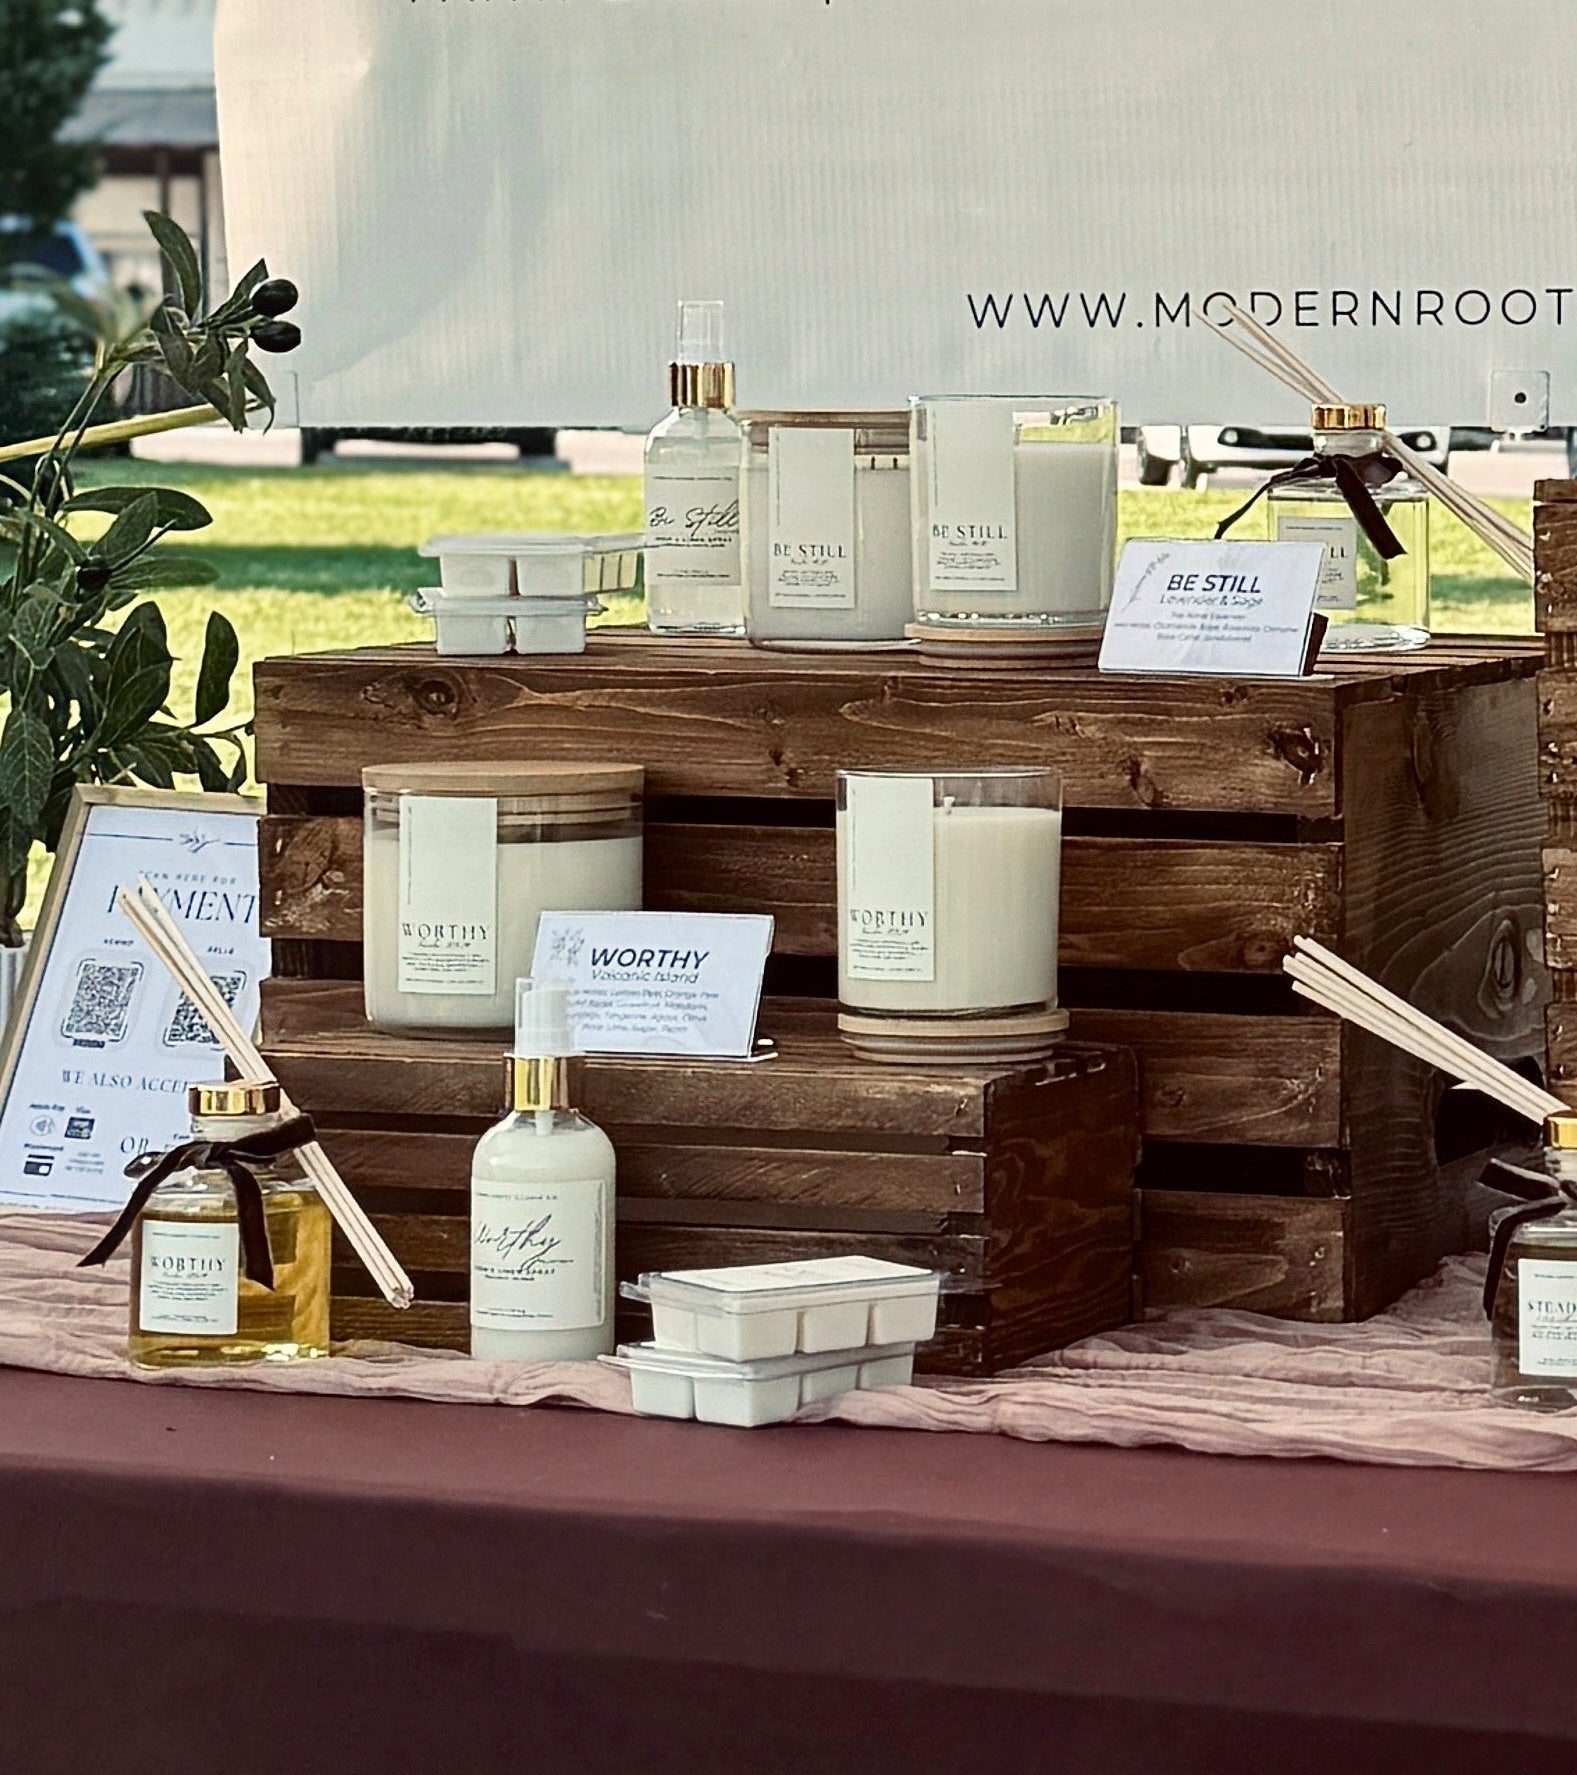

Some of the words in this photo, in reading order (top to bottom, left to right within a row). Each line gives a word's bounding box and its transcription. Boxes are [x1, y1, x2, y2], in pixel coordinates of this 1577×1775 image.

[932, 524, 949, 538] BE
[957, 525, 1007, 540] STILL
[774, 543, 791, 557] BE
[798, 544, 847, 559] STILL
[1167, 574, 1199, 592] BE
[1202, 574, 1262, 594] STILL
[402, 922, 490, 940] WORTHY
[590, 947, 710, 970] WORTHY
[91, 1071, 133, 1088] ALSO
